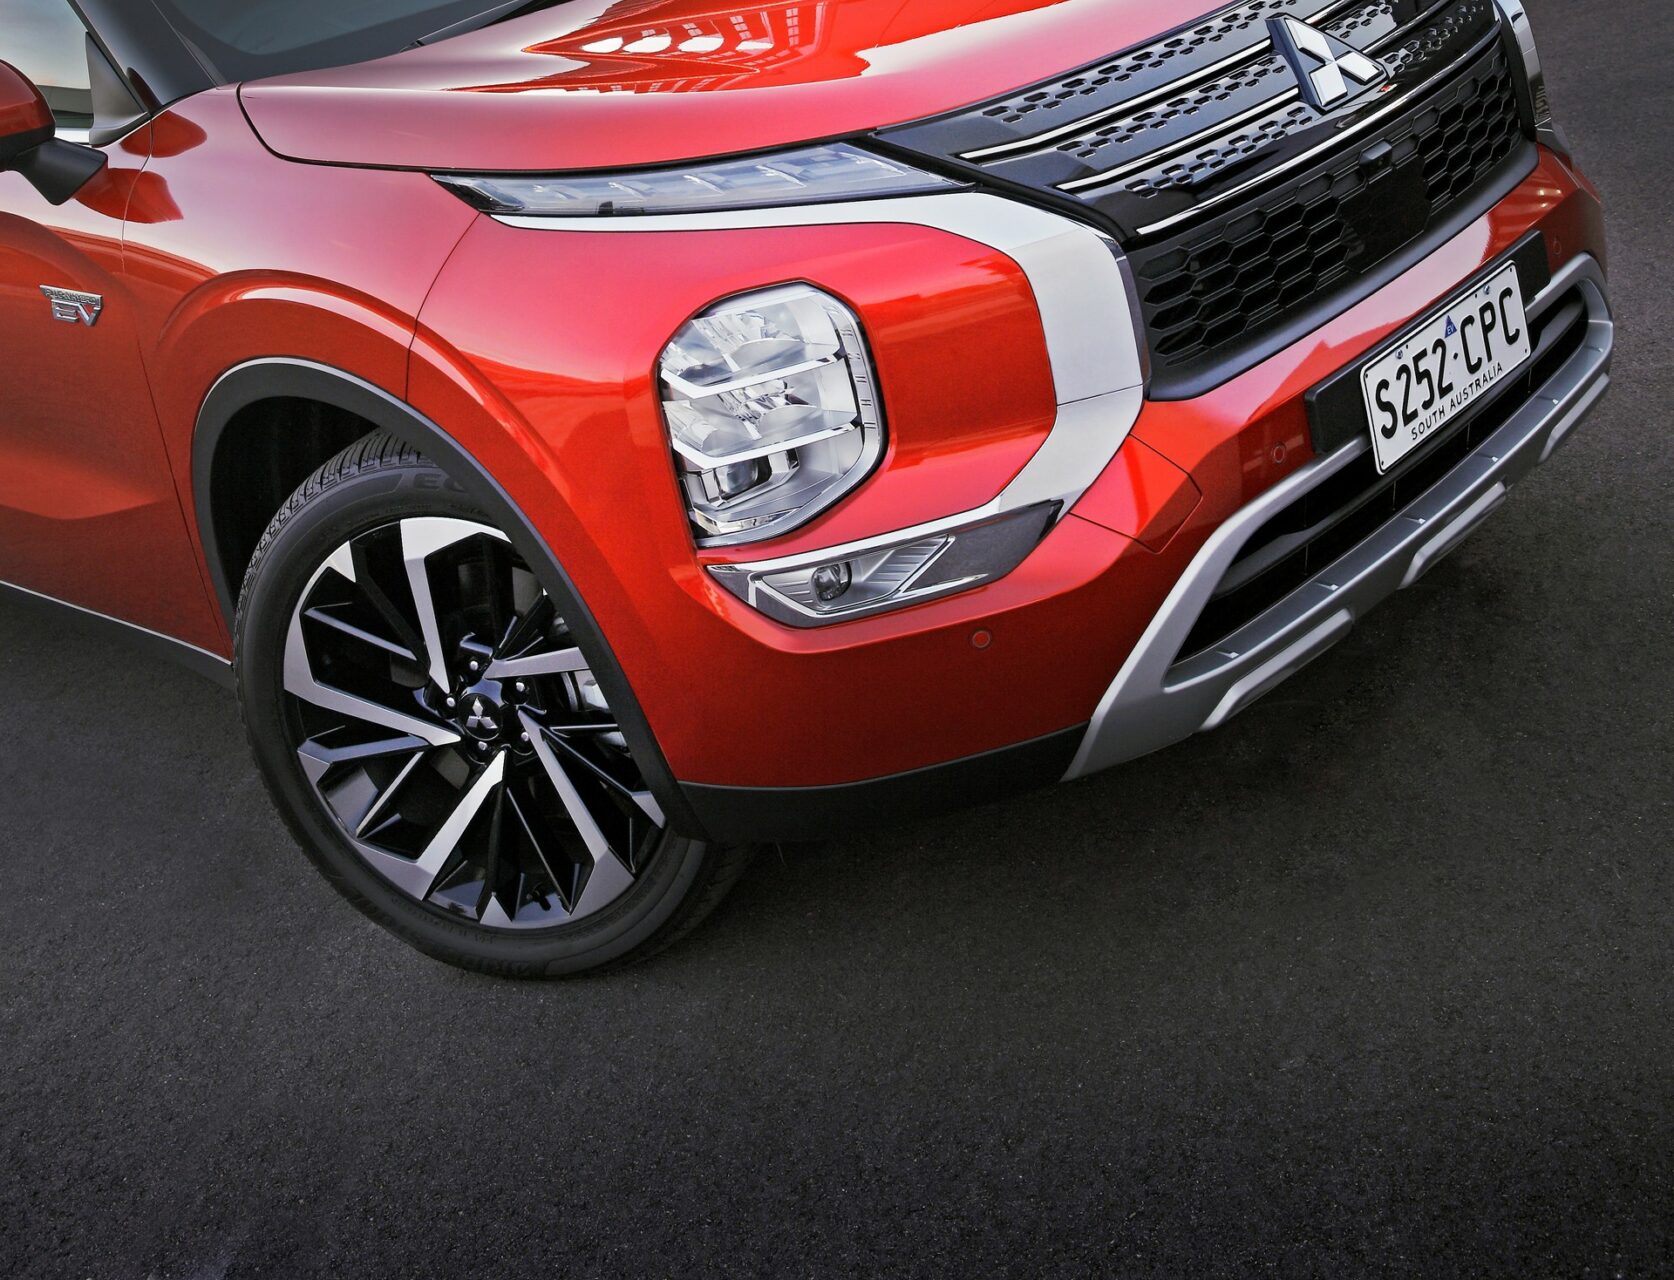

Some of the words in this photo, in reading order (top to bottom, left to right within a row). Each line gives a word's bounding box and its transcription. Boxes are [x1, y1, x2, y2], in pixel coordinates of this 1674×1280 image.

[51, 299, 101, 326] EV
[1411, 405, 1446, 441] SOUTH
[1449, 361, 1503, 412] AUSTRALIA
